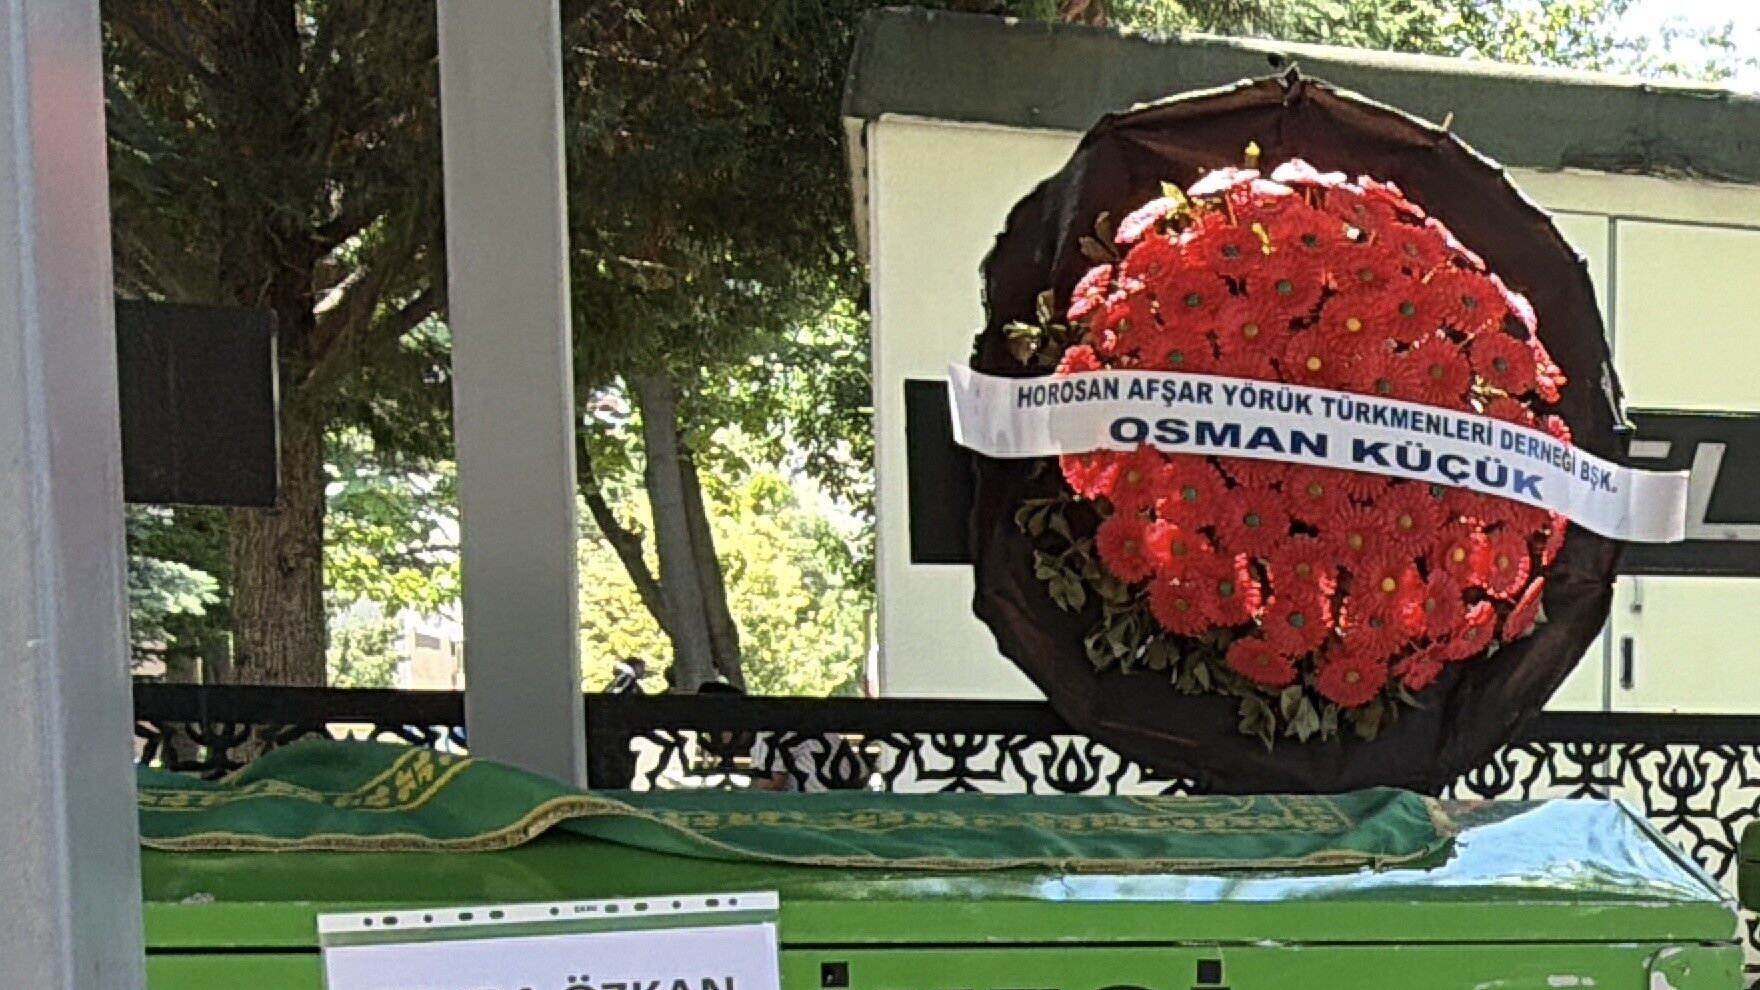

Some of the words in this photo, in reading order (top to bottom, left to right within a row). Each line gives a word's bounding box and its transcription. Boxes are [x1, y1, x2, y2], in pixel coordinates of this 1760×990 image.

[1016, 377, 1120, 409] HOROSAN
[1128, 377, 1214, 407] AFŞAR
[1221, 382, 1313, 415] YÖRÜK
[1320, 394, 1493, 447] TÜRKMENLERİ
[1500, 428, 1576, 477] DERNEĞİ
[1580, 464, 1618, 494] BŞK.
[1109, 416, 1328, 459] OSMAN
[1352, 438, 1544, 501] KÜÇÜK
